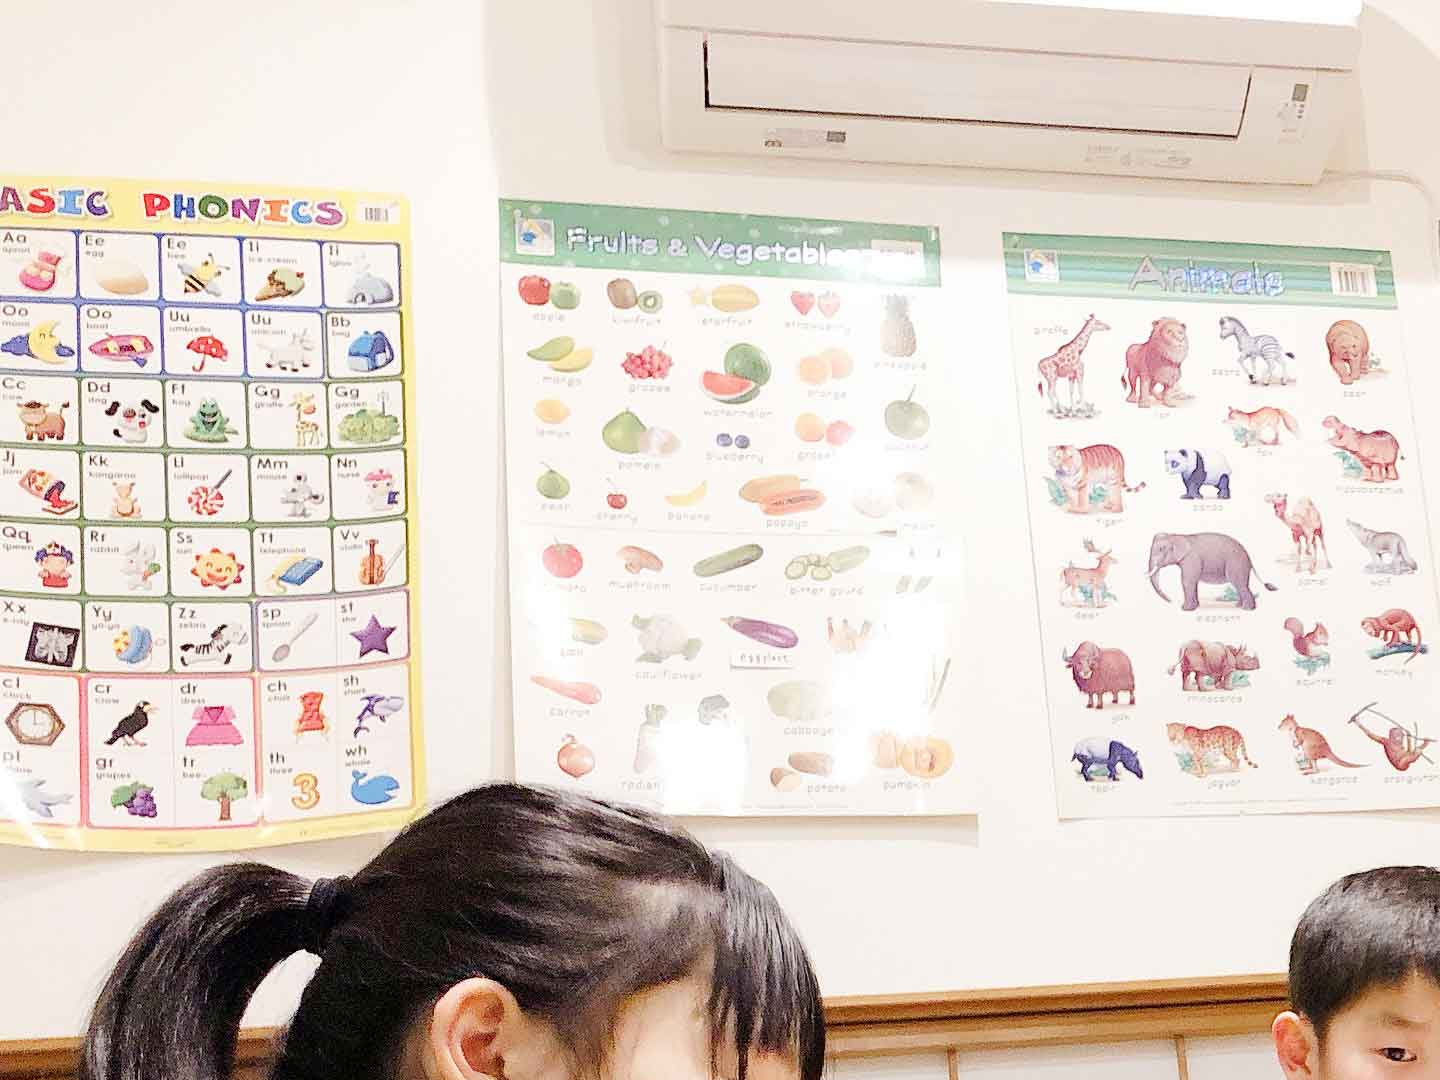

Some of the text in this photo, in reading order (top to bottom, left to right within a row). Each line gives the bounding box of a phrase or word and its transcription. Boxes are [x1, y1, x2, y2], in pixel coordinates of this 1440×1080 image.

[143, 192, 344, 227] PHONICS
[3, 232, 27, 244] Aa
[85, 235, 105, 247] Ee
[167, 238, 187, 250] Ee
[567, 225, 864, 267] Fruits & Vegetabl
[1128, 254, 1285, 296] Animals
[2, 304, 29, 317] Oo
[86, 307, 112, 320] Oo
[169, 310, 190, 323] Uu
[251, 314, 271, 326] Uu
[331, 317, 351, 328] Bb
[2, 378, 26, 390] Cc
[88, 382, 111, 393] Dd
[255, 385, 280, 399] Gg
[335, 386, 360, 399] Gg
[89, 456, 109, 467] Kk
[257, 459, 289, 470] Mm
[337, 458, 357, 469] Nn
[2, 526, 32, 543] Qq
[177, 532, 193, 544] Ss
[340, 529, 360, 540] Vv
[3, 602, 26, 614] Xx
[179, 608, 196, 620] Zz
[92, 607, 112, 622] Yy
[267, 680, 287, 693] ch
[345, 745, 367, 757] wh
